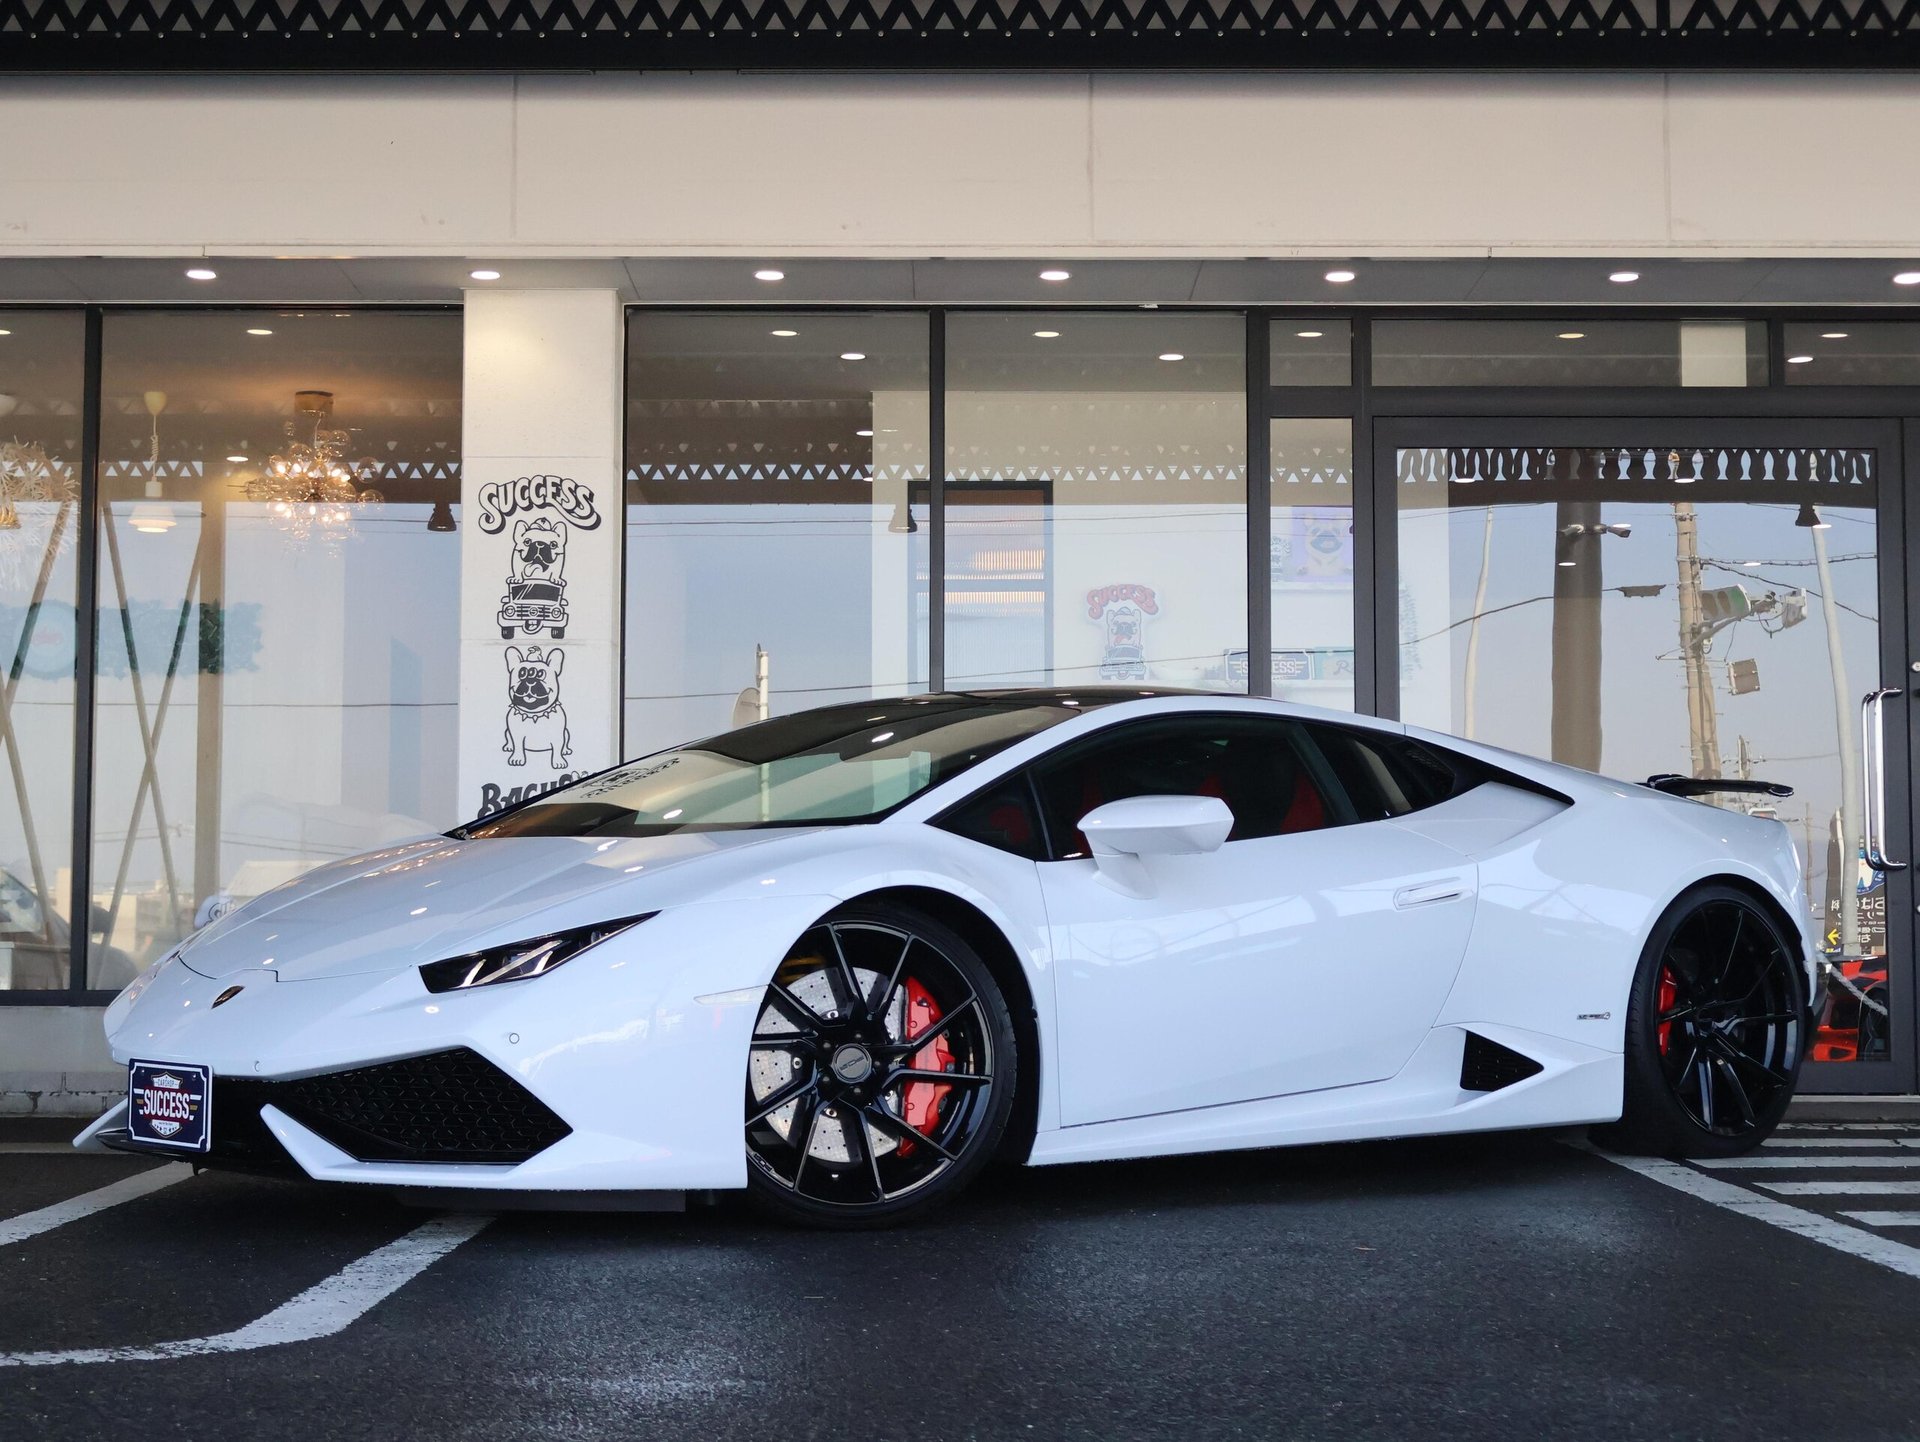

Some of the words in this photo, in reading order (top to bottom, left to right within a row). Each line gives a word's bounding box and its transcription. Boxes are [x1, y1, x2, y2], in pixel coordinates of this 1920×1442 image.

[478, 474, 601, 535] SUCCESS
[1088, 584, 1159, 620] SUCCESS
[143, 1089, 189, 1119] SUCCESS
